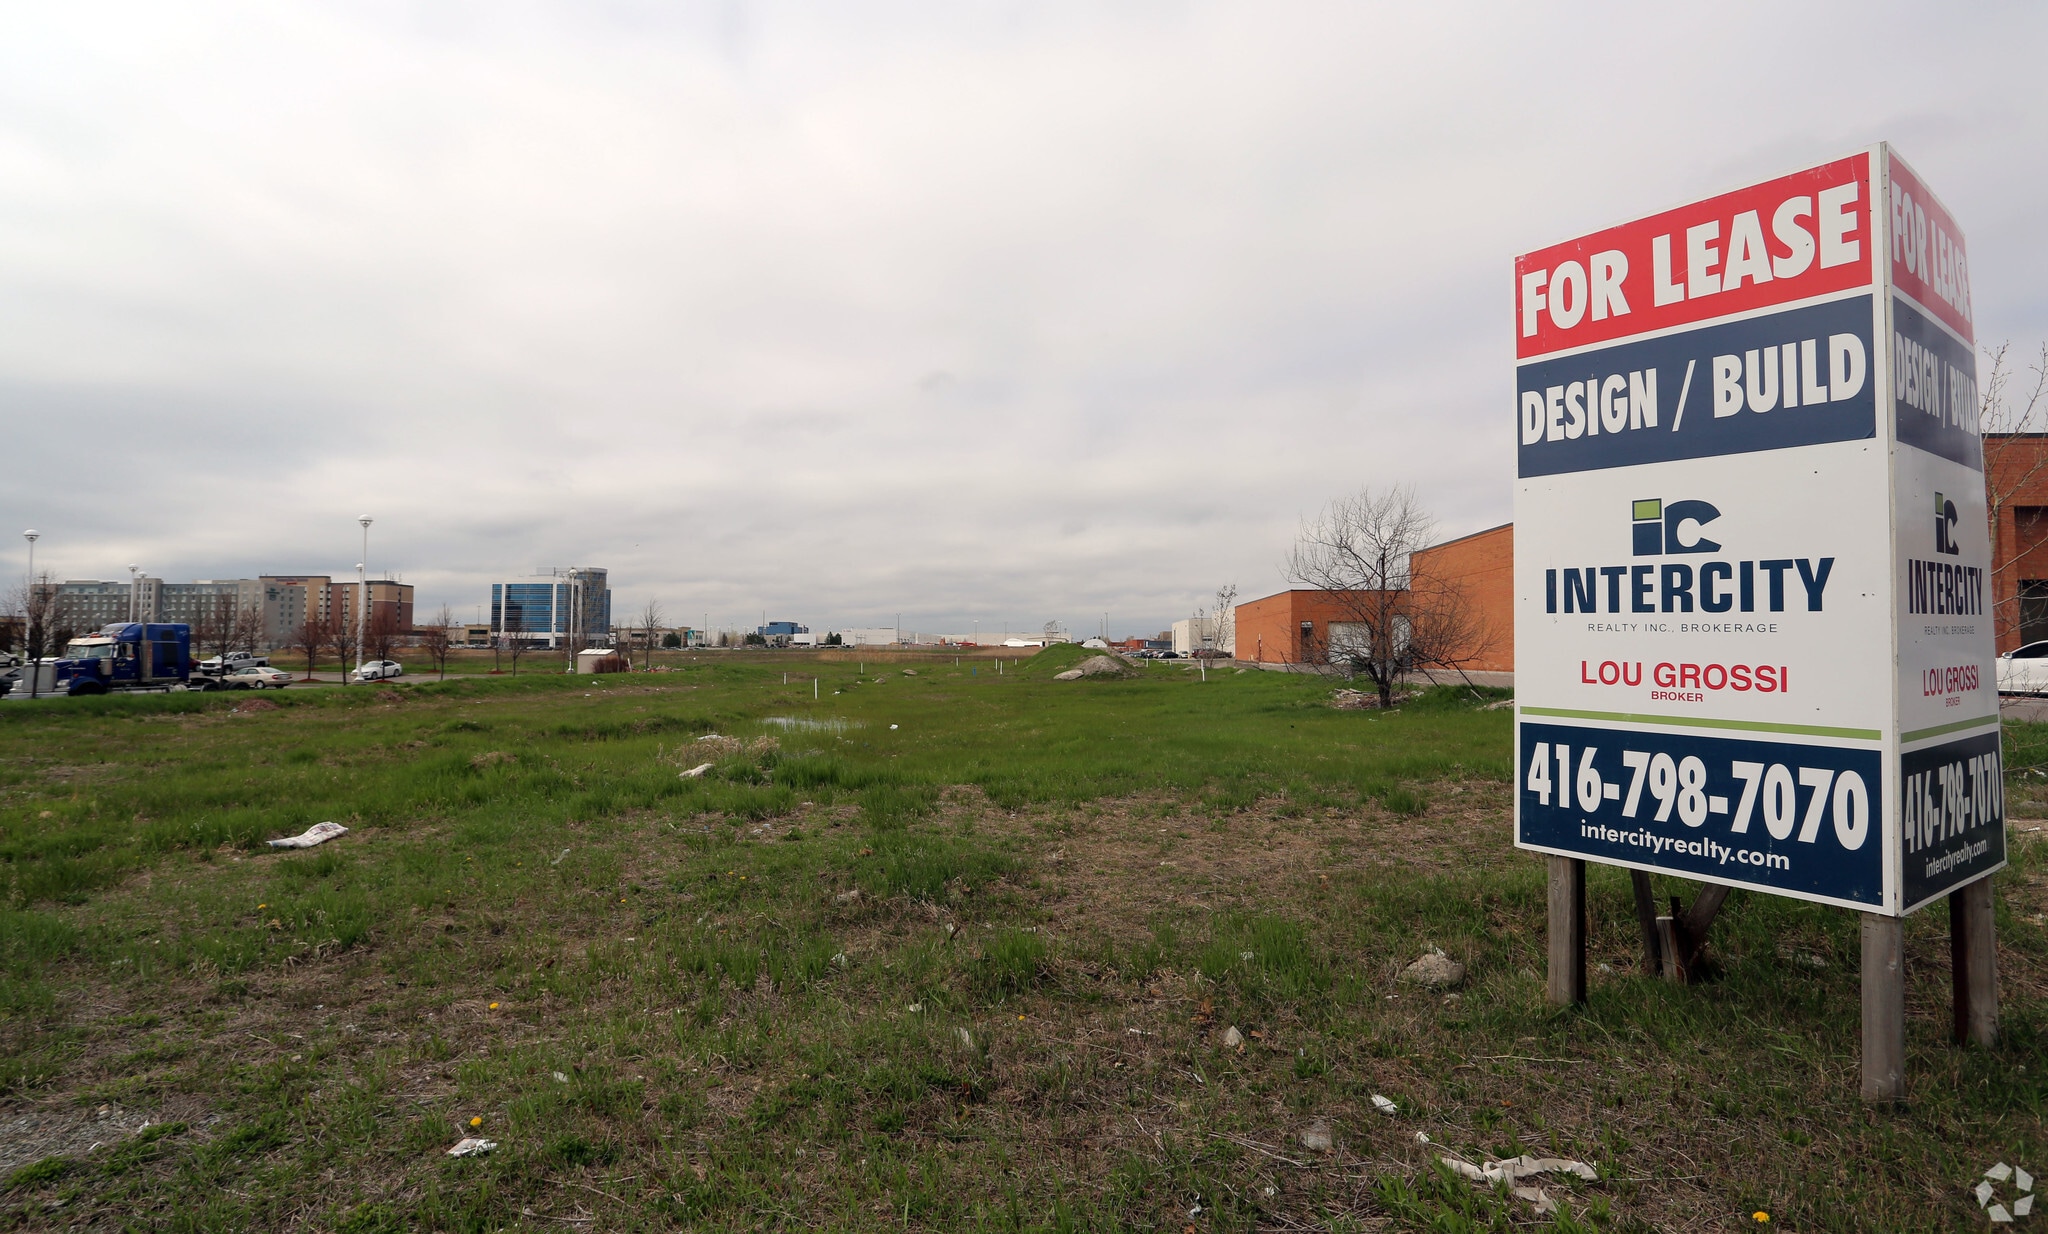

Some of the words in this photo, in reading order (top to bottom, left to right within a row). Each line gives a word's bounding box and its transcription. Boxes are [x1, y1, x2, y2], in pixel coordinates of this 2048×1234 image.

[1521, 249, 1631, 338] FOR
[1652, 181, 1861, 308] LEASE
[1891, 180, 1929, 285] FOR
[1931, 219, 1971, 324] LEASE
[1521, 368, 1658, 446] DESIGN
[1672, 360, 1696, 432] /
[1713, 333, 1866, 418] BUILD
[1895, 331, 1940, 418] DESIGN
[1942, 360, 1948, 428] /
[1950, 364, 1979, 436] BUILD
[1545, 557, 1835, 615] INTERCITY
[1908, 559, 1982, 615] INTERCITY
[1587, 623, 1638, 632] REALTY
[1681, 623, 1778, 633] BROKERAGE
[1581, 660, 1642, 687] LOU
[1653, 662, 1788, 693] GROSSI
[1651, 690, 1704, 702] BROKER
[1923, 668, 1943, 697] LOU
[1946, 665, 1979, 694] GROSSI
[1527, 742, 1869, 851] 416-798-7070
[1905, 751, 1999, 854] 416-798-7070
[1580, 819, 1790, 870] intercityrealty.com
[1926, 839, 1988, 878] intercityrealty.com
